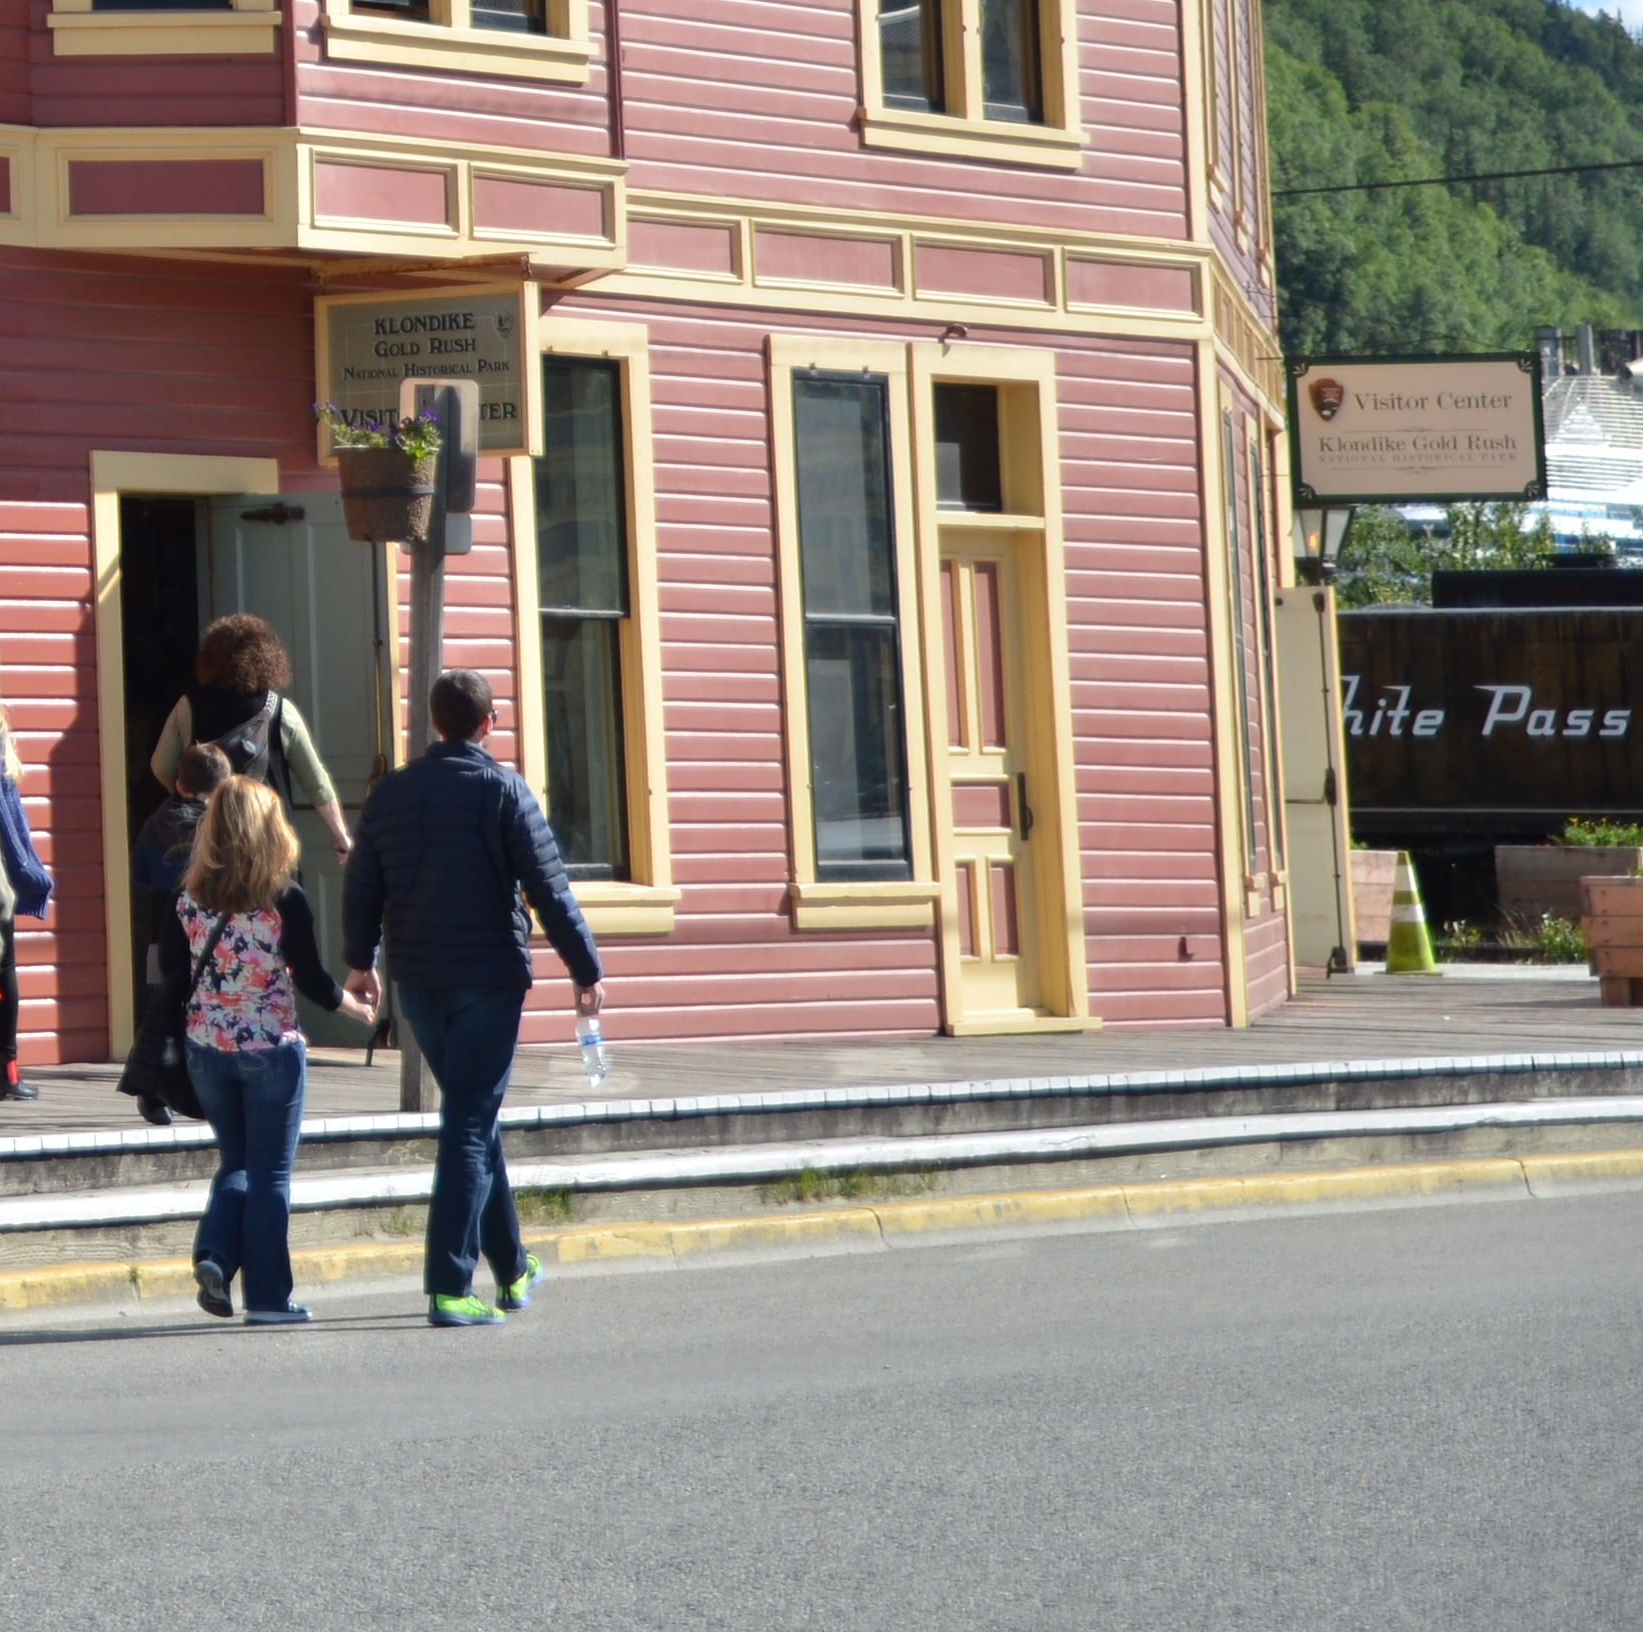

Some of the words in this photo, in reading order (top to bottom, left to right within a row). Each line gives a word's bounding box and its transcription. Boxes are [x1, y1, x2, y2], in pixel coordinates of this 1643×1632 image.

[373, 312, 476, 336] KLONDIKE
[373, 340, 420, 357] GOLD
[428, 337, 477, 355] RUSH
[343, 366, 399, 381] NATIONAL
[403, 362, 473, 377] HISTORICAL
[477, 359, 510, 373] PARK
[1354, 392, 1429, 410] Visitor
[1436, 391, 1513, 409] Center
[340, 409, 400, 426] VISIT
[1318, 436, 1407, 452] Klondike
[1412, 435, 1458, 451] Gold
[1467, 434, 1517, 450] Rush
[1318, 454, 1386, 463] NATIONAL
[1393, 453, 1475, 462] HISTORICAL
[1481, 452, 1517, 460] PARK
[1339, 675, 1445, 735] hite
[1473, 685, 1632, 736] Pass
